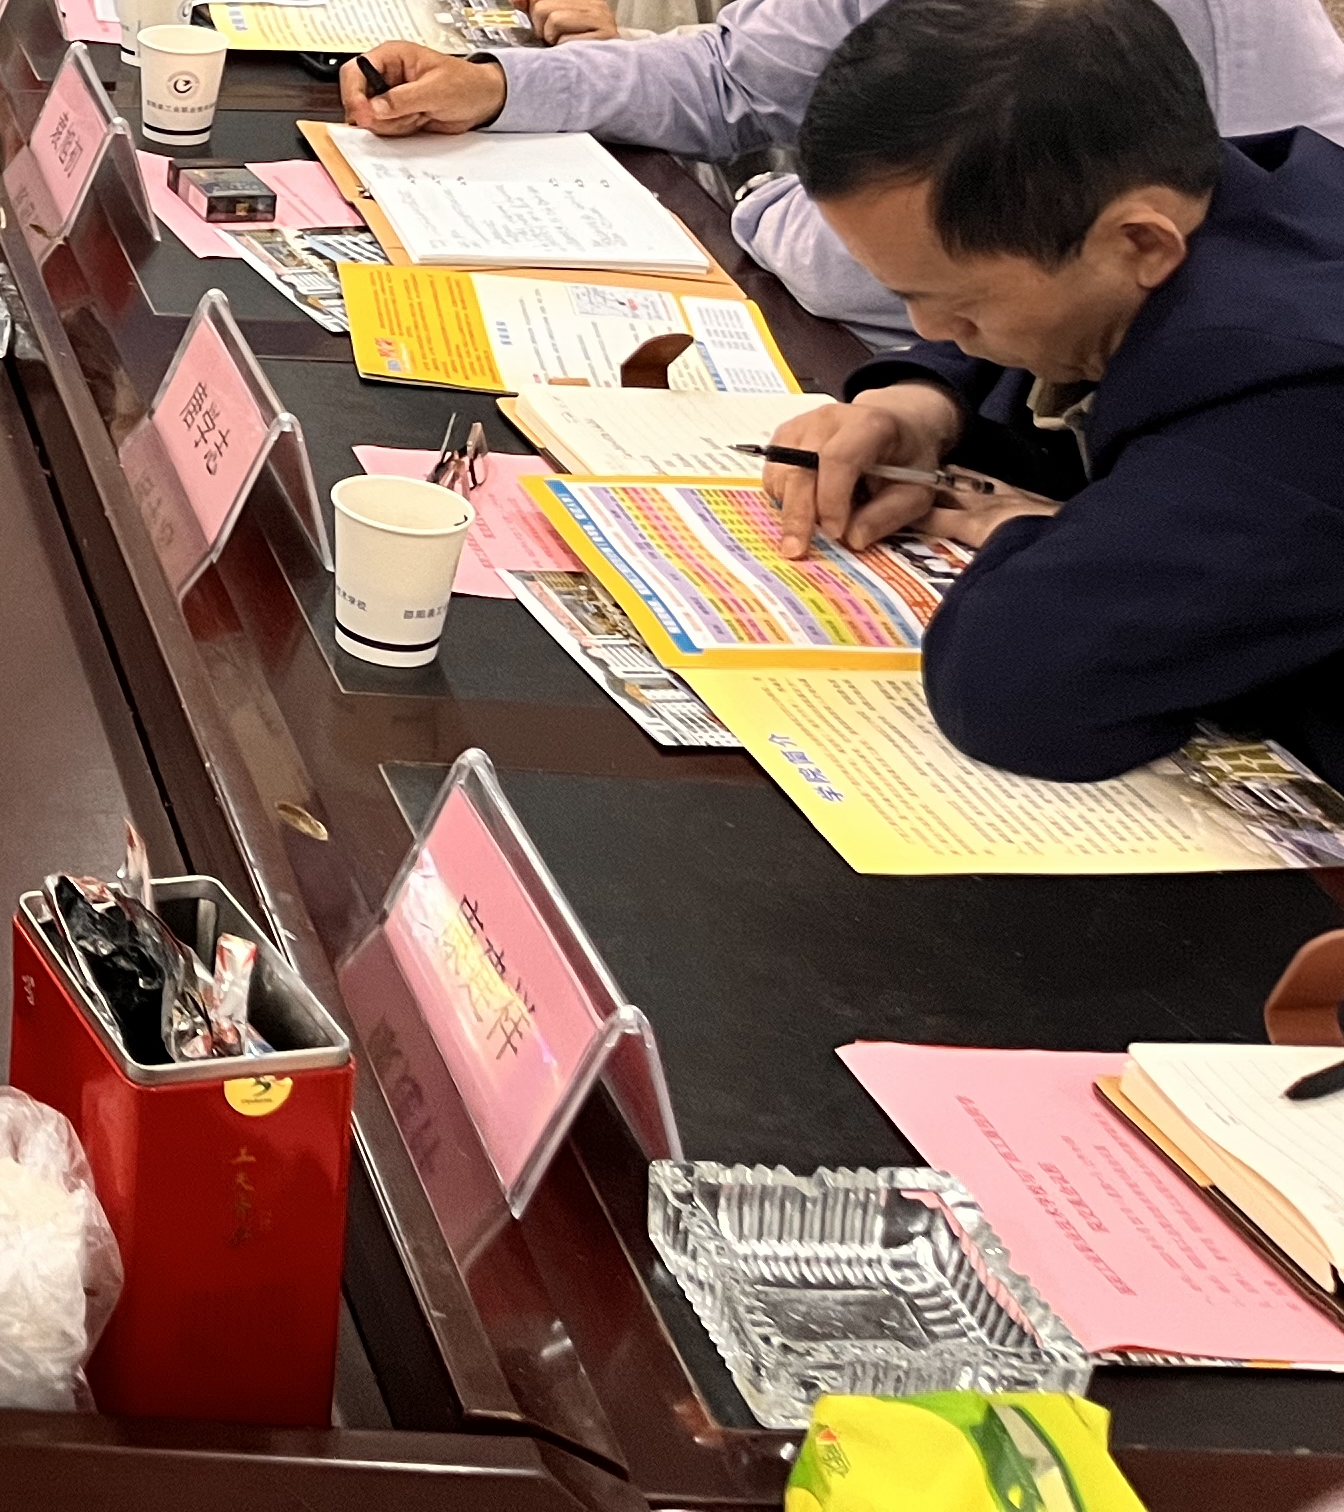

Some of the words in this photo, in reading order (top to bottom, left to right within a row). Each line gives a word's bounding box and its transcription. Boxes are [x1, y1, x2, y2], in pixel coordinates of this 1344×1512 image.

[179, 381, 231, 476] 唐学志
[768, 733, 844, 802] 学院简介
